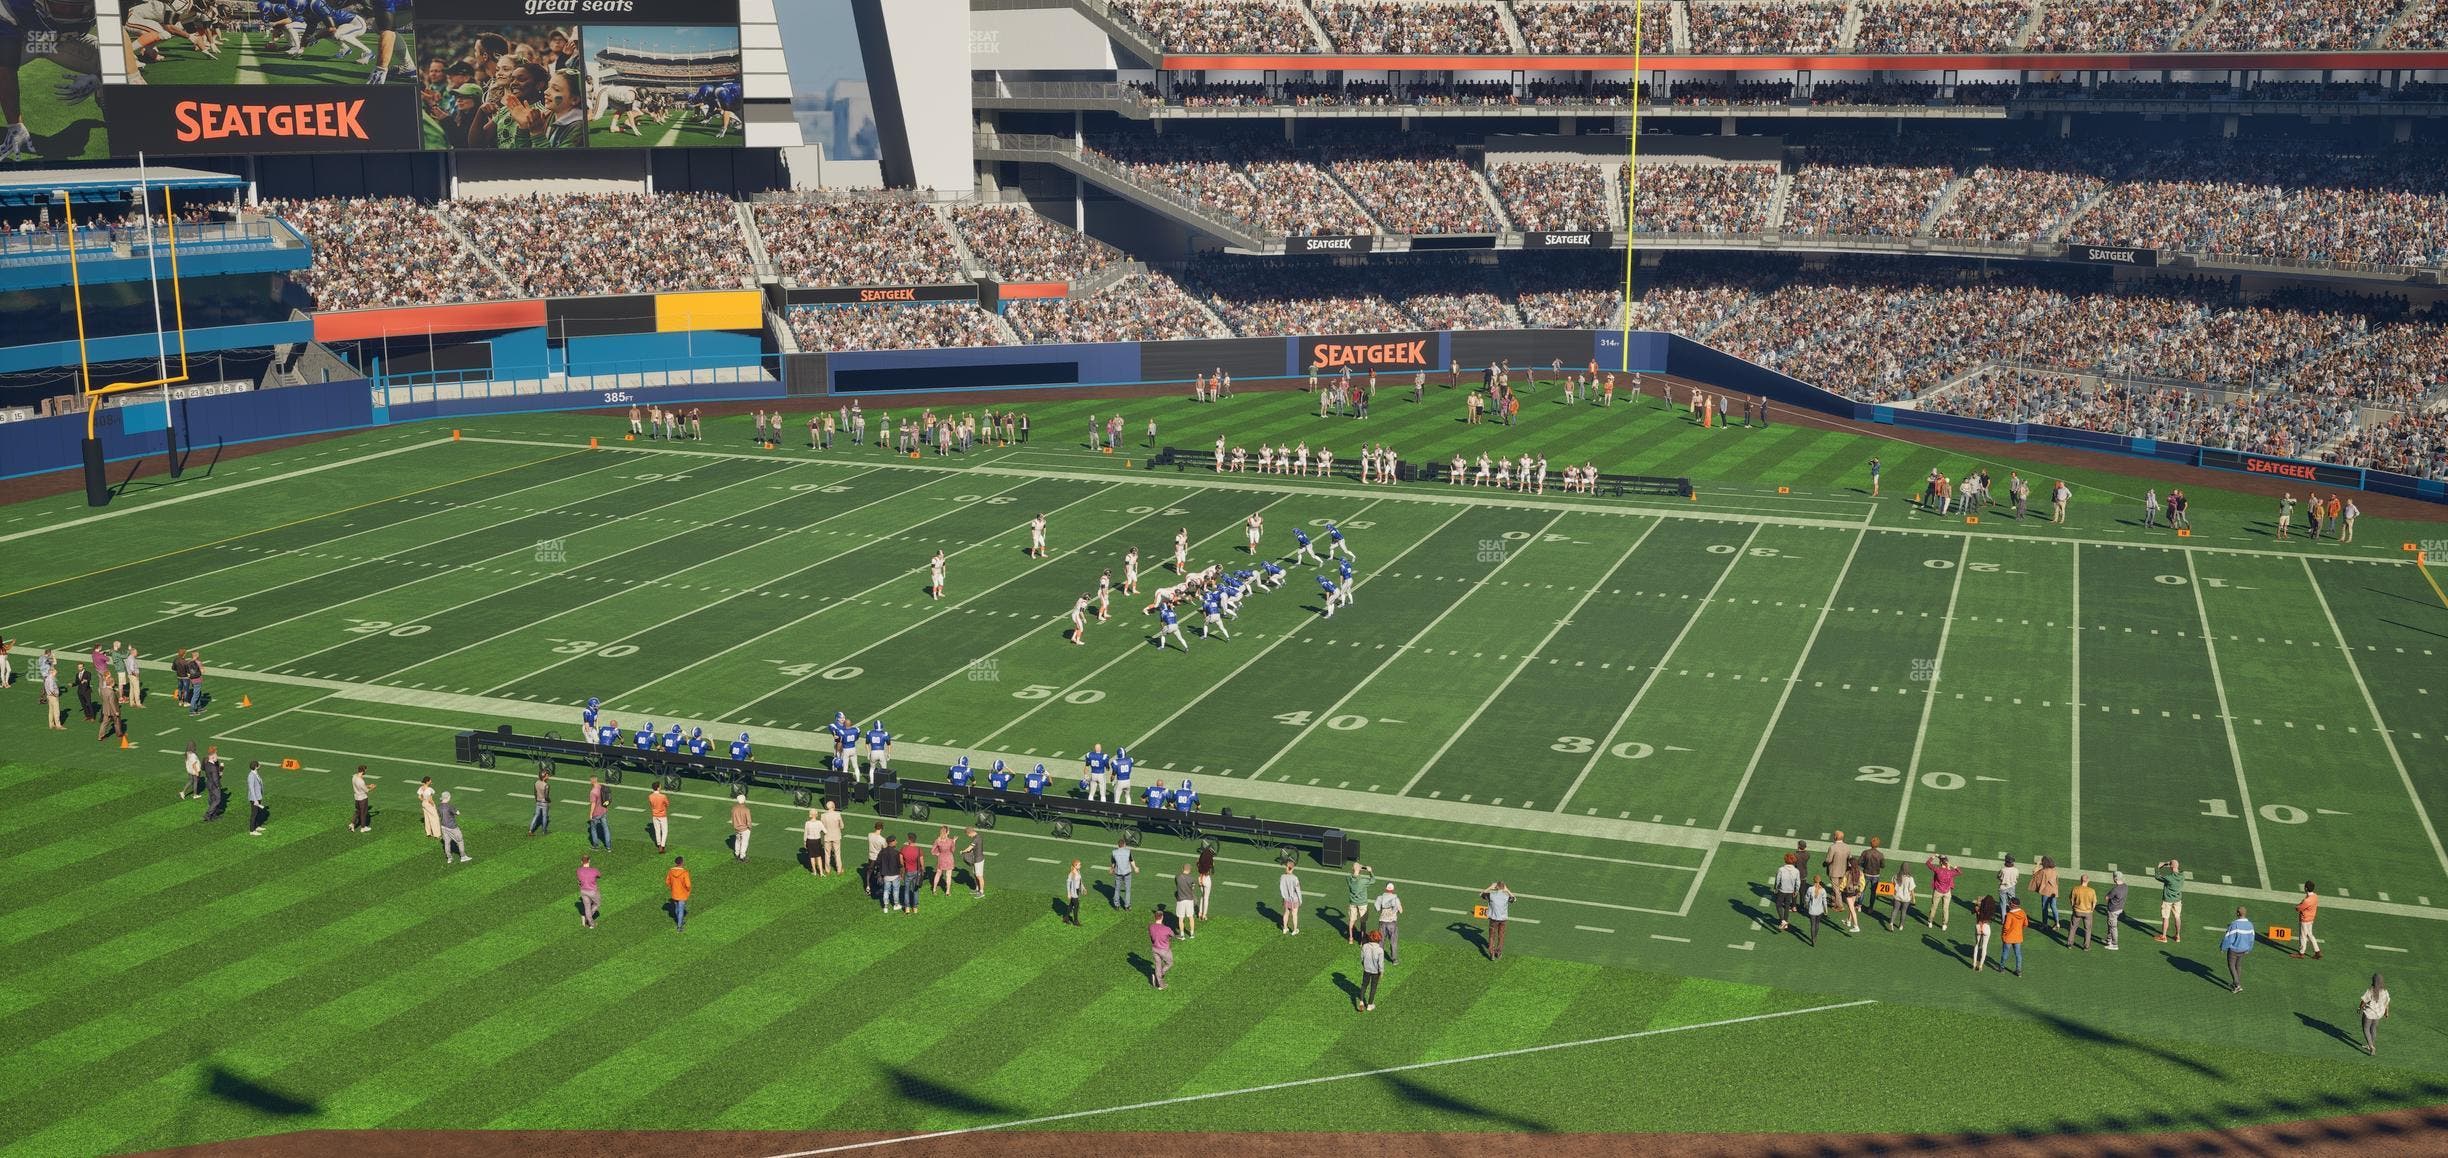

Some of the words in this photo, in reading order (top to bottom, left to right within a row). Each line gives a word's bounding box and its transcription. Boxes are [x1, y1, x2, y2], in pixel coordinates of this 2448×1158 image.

[524, 0, 578, 15] great
[582, 0, 633, 12] seats
[175, 99, 369, 142] SEATGEEK
[1307, 238, 1352, 250] SEATGEEK
[1545, 234, 1591, 246] SEATGEEK
[2088, 248, 2135, 263] SEATGEEK
[860, 289, 915, 301] SEATGEEK
[1314, 340, 1427, 368] SEATGEEK
[2246, 458, 2317, 481] SEATGEEK
[158, 603, 238, 617] 10
[343, 621, 432, 637] 20
[551, 640, 640, 658] 30
[776, 663, 864, 680] 40
[1012, 685, 1106, 704] 50
[1272, 710, 1369, 730] 40
[1550, 736, 1654, 759] 30
[285, 760, 294, 768] 30
[1854, 765, 1966, 790] 20
[2198, 798, 2309, 824] 10
[1880, 884, 1890, 893] 20
[2275, 929, 2285, 938] 10
